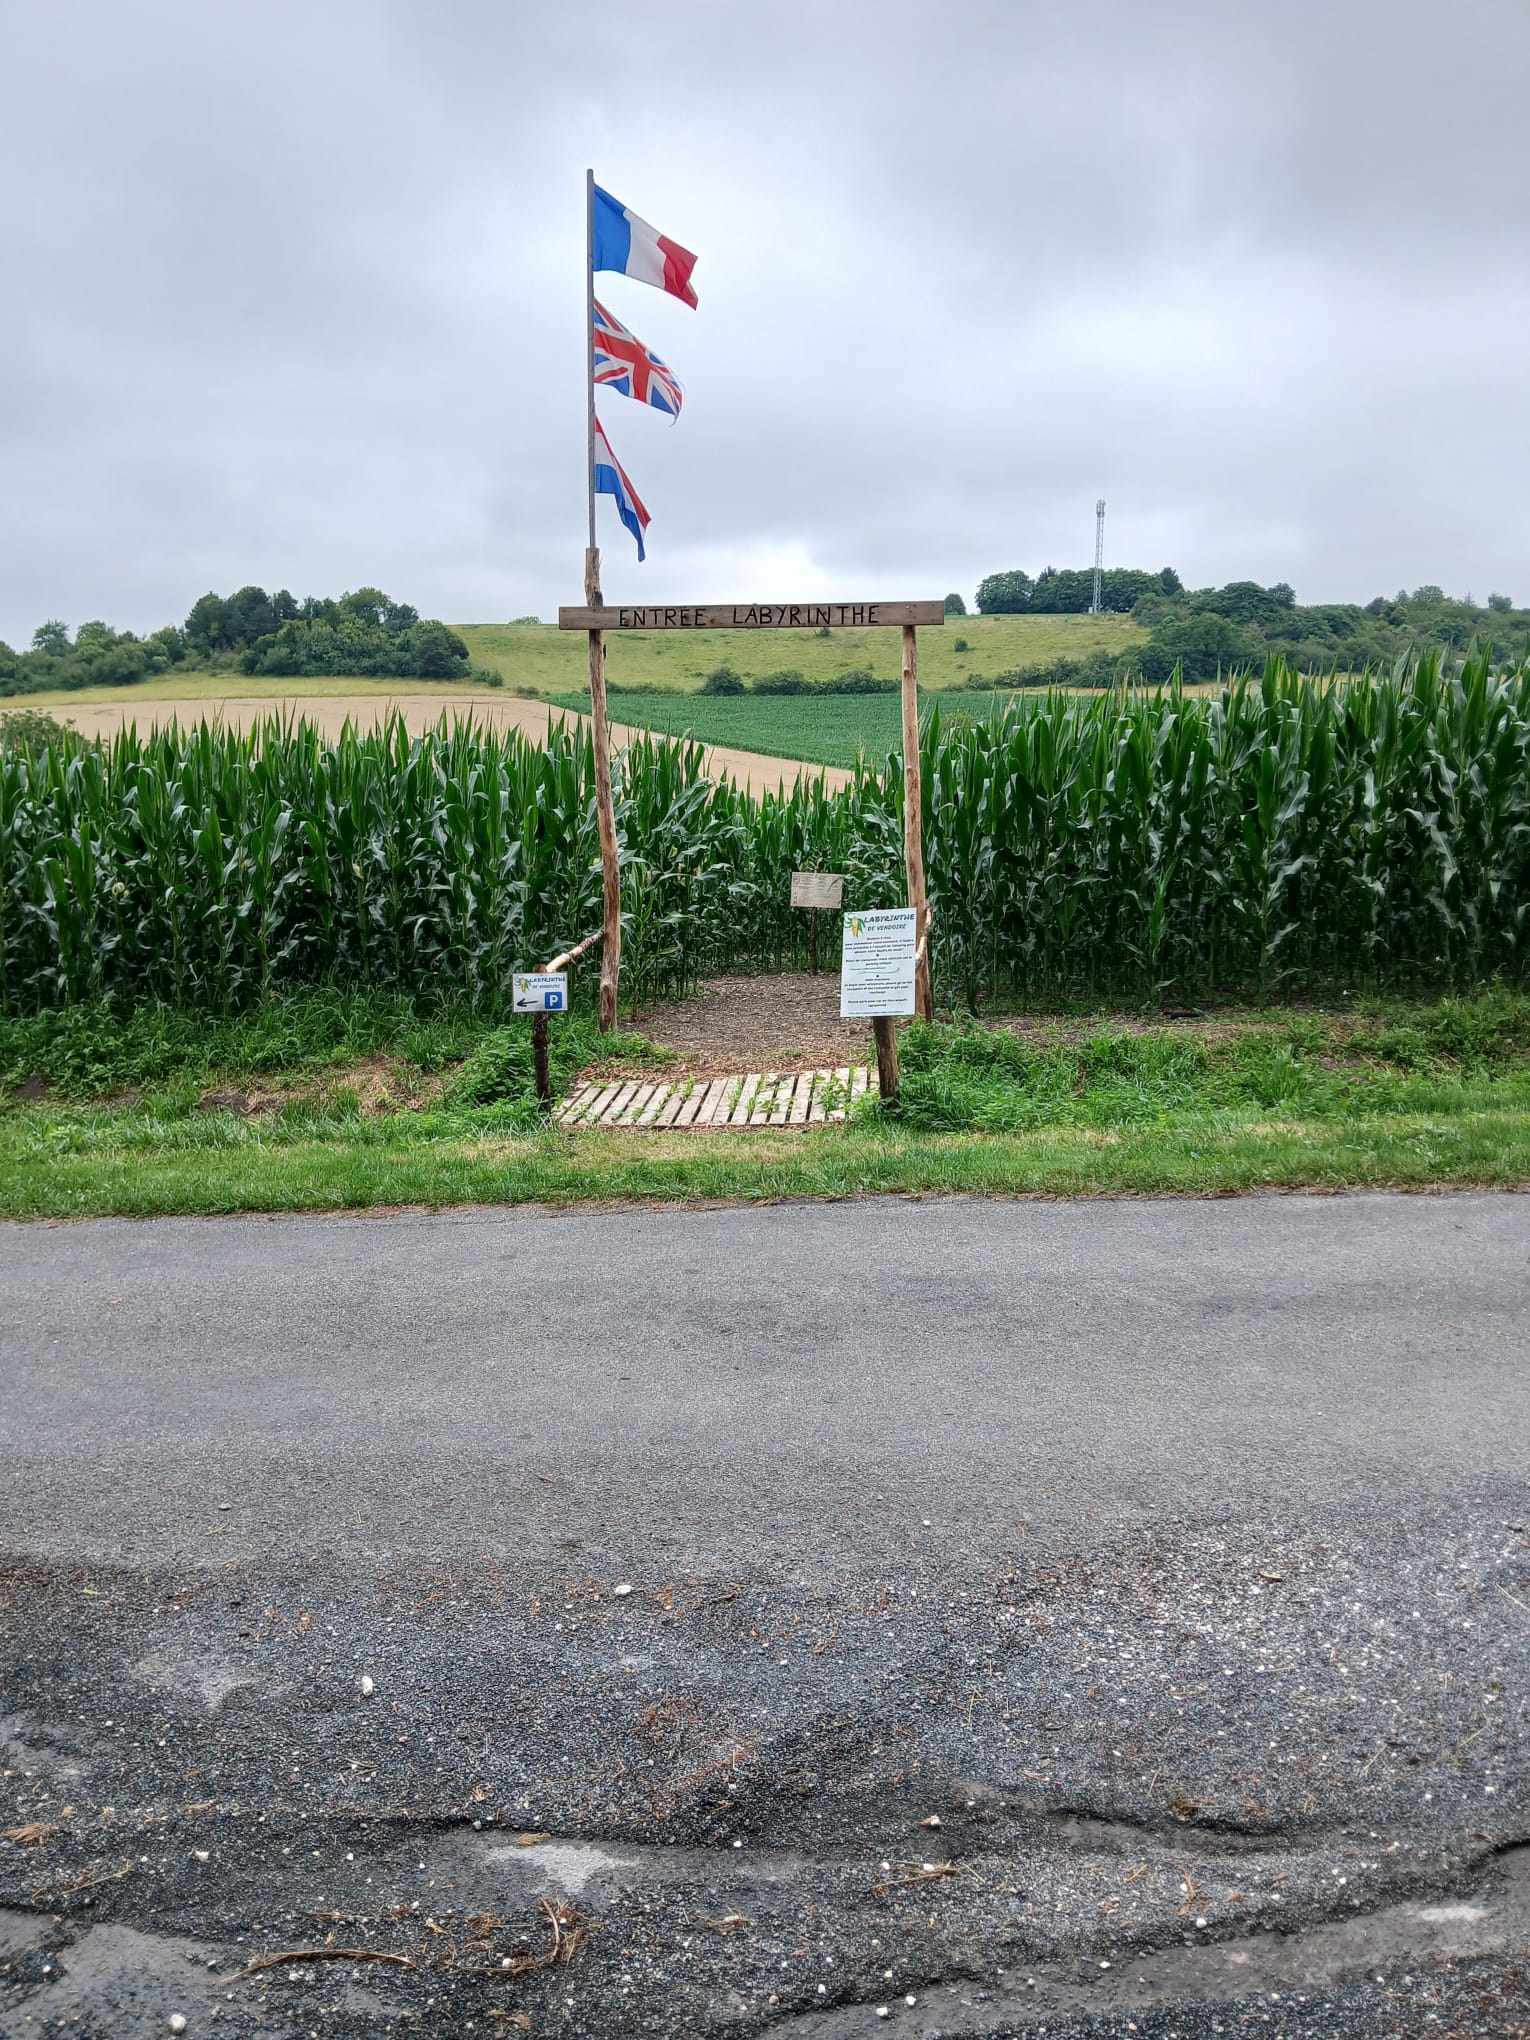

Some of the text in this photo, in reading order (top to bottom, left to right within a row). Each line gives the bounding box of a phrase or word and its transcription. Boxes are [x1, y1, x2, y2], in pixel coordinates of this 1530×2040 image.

[618, 605, 881, 627] ENTREE LABYRINTHE
[864, 913, 915, 923] LABYRINTHE
